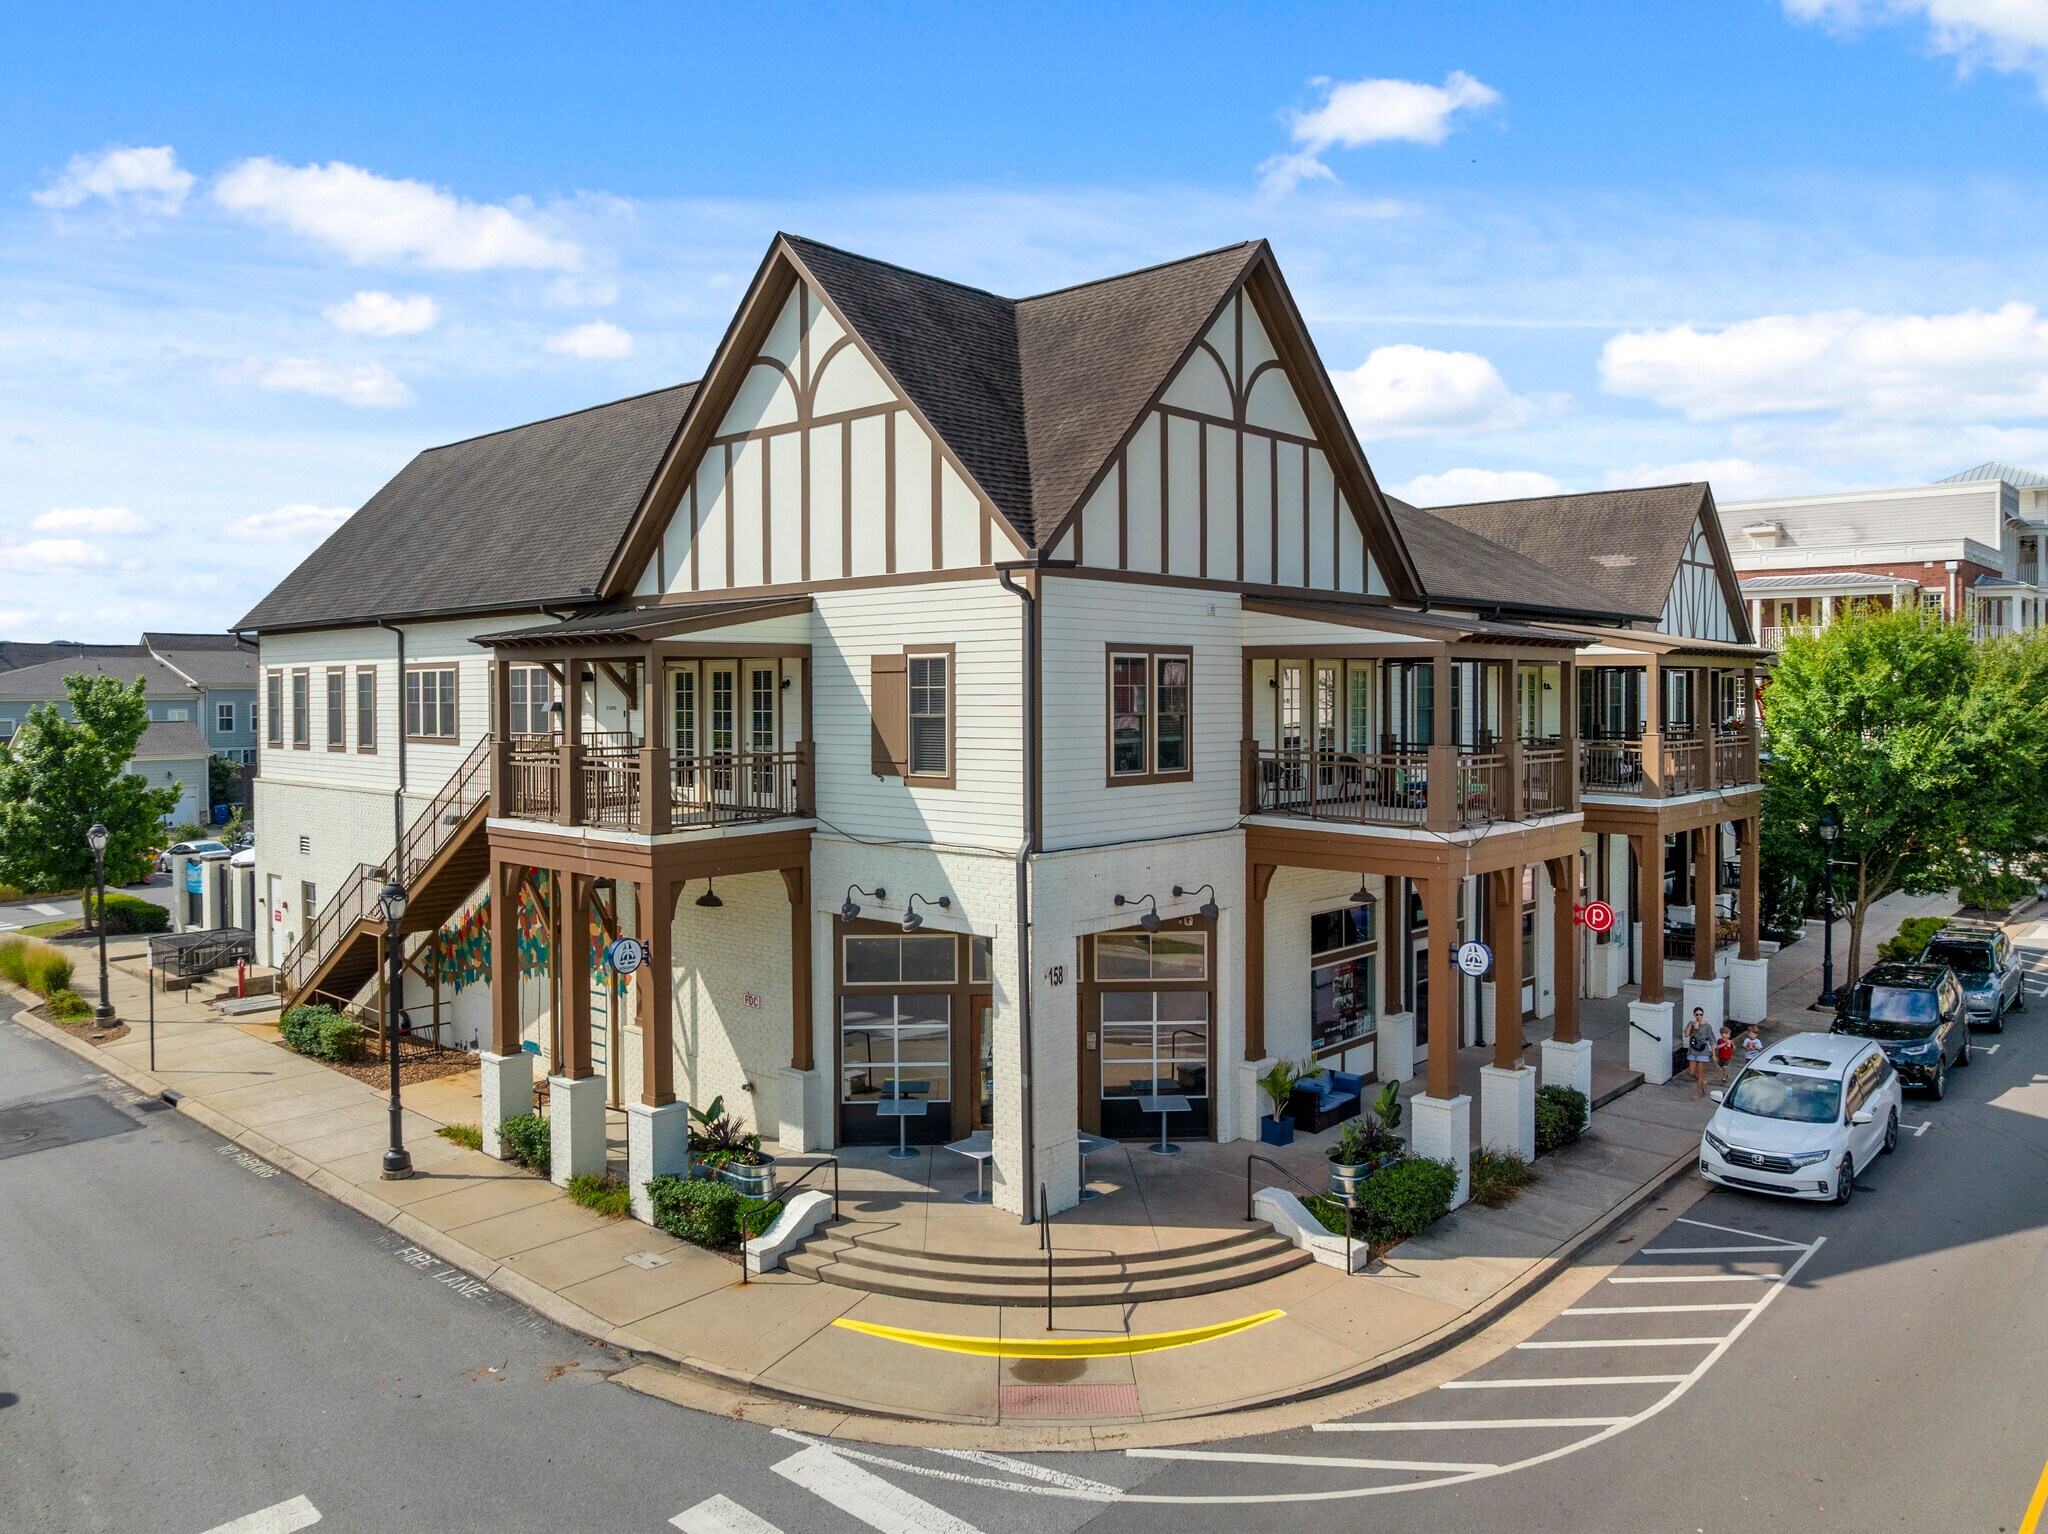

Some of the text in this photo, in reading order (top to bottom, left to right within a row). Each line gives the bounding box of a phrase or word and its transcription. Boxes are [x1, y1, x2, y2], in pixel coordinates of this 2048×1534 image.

[1048, 965, 1064, 987] 158
[744, 995, 759, 1007] FDC
[394, 1246, 490, 1298] FIRE LANE
